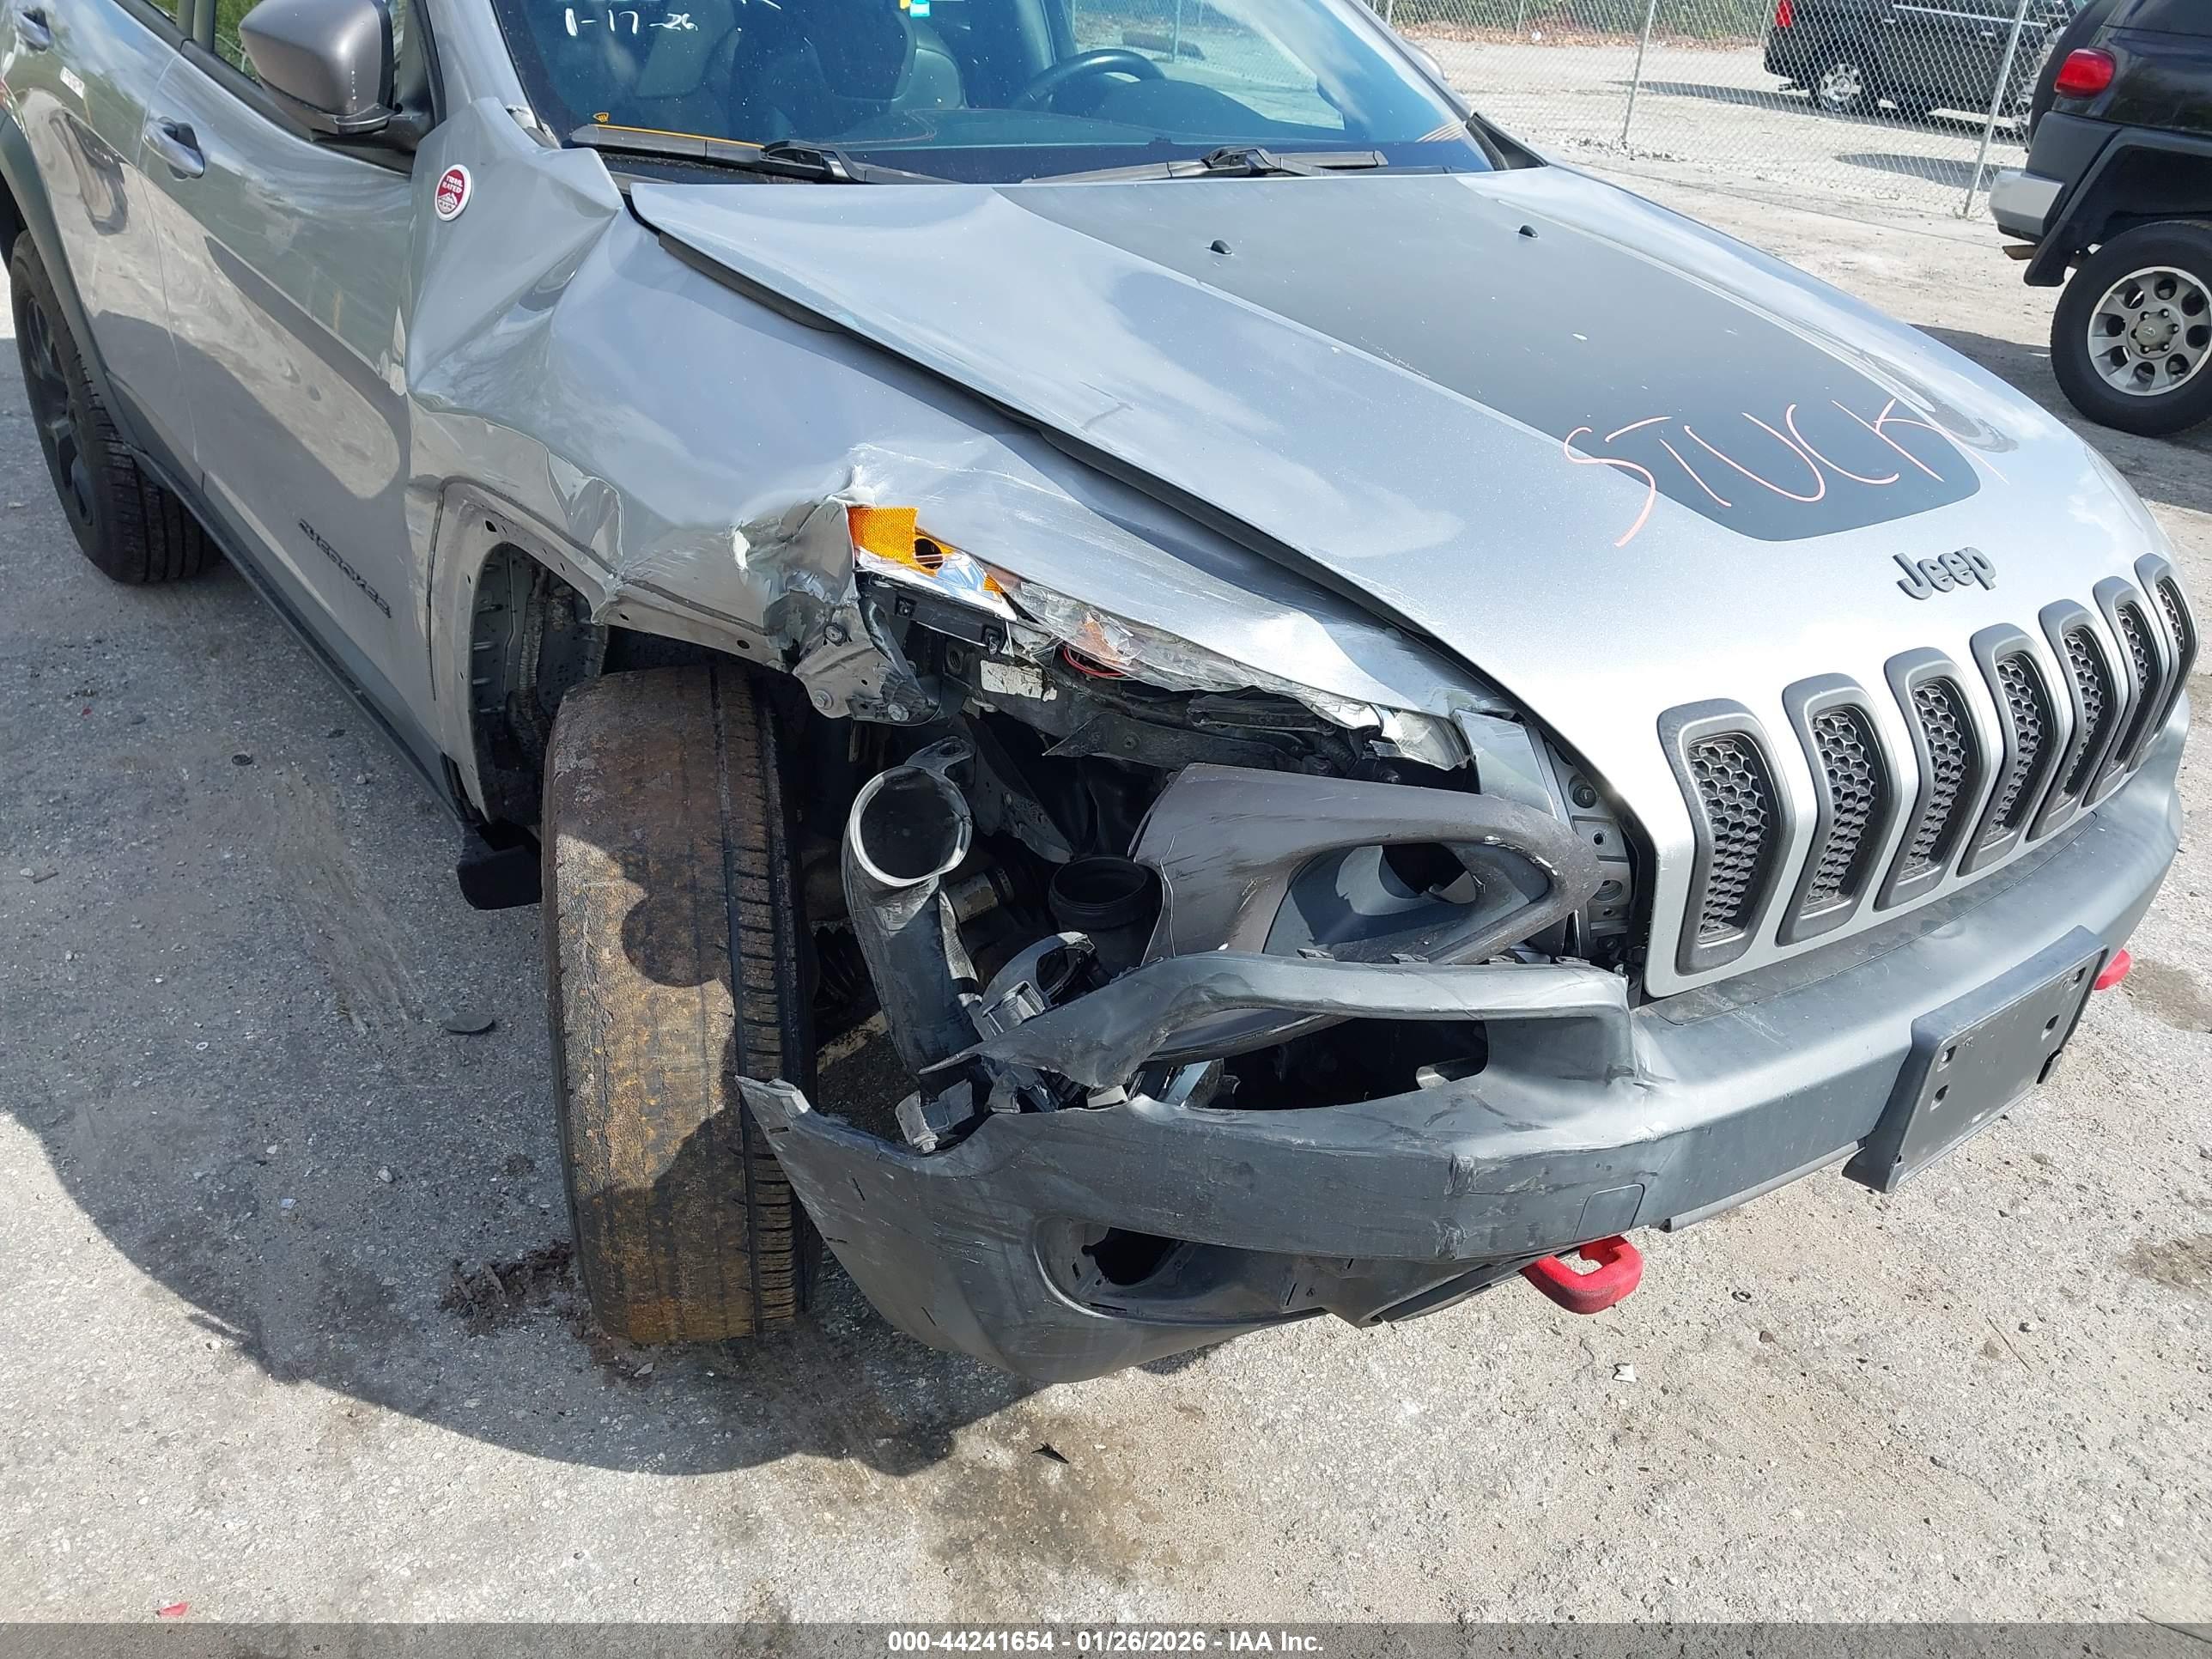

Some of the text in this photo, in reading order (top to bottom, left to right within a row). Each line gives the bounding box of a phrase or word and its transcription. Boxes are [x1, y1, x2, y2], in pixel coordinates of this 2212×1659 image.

[442, 181, 463, 194] RATED
[1563, 398, 2009, 547] STUCK
[1892, 546, 1996, 600] Jeep
